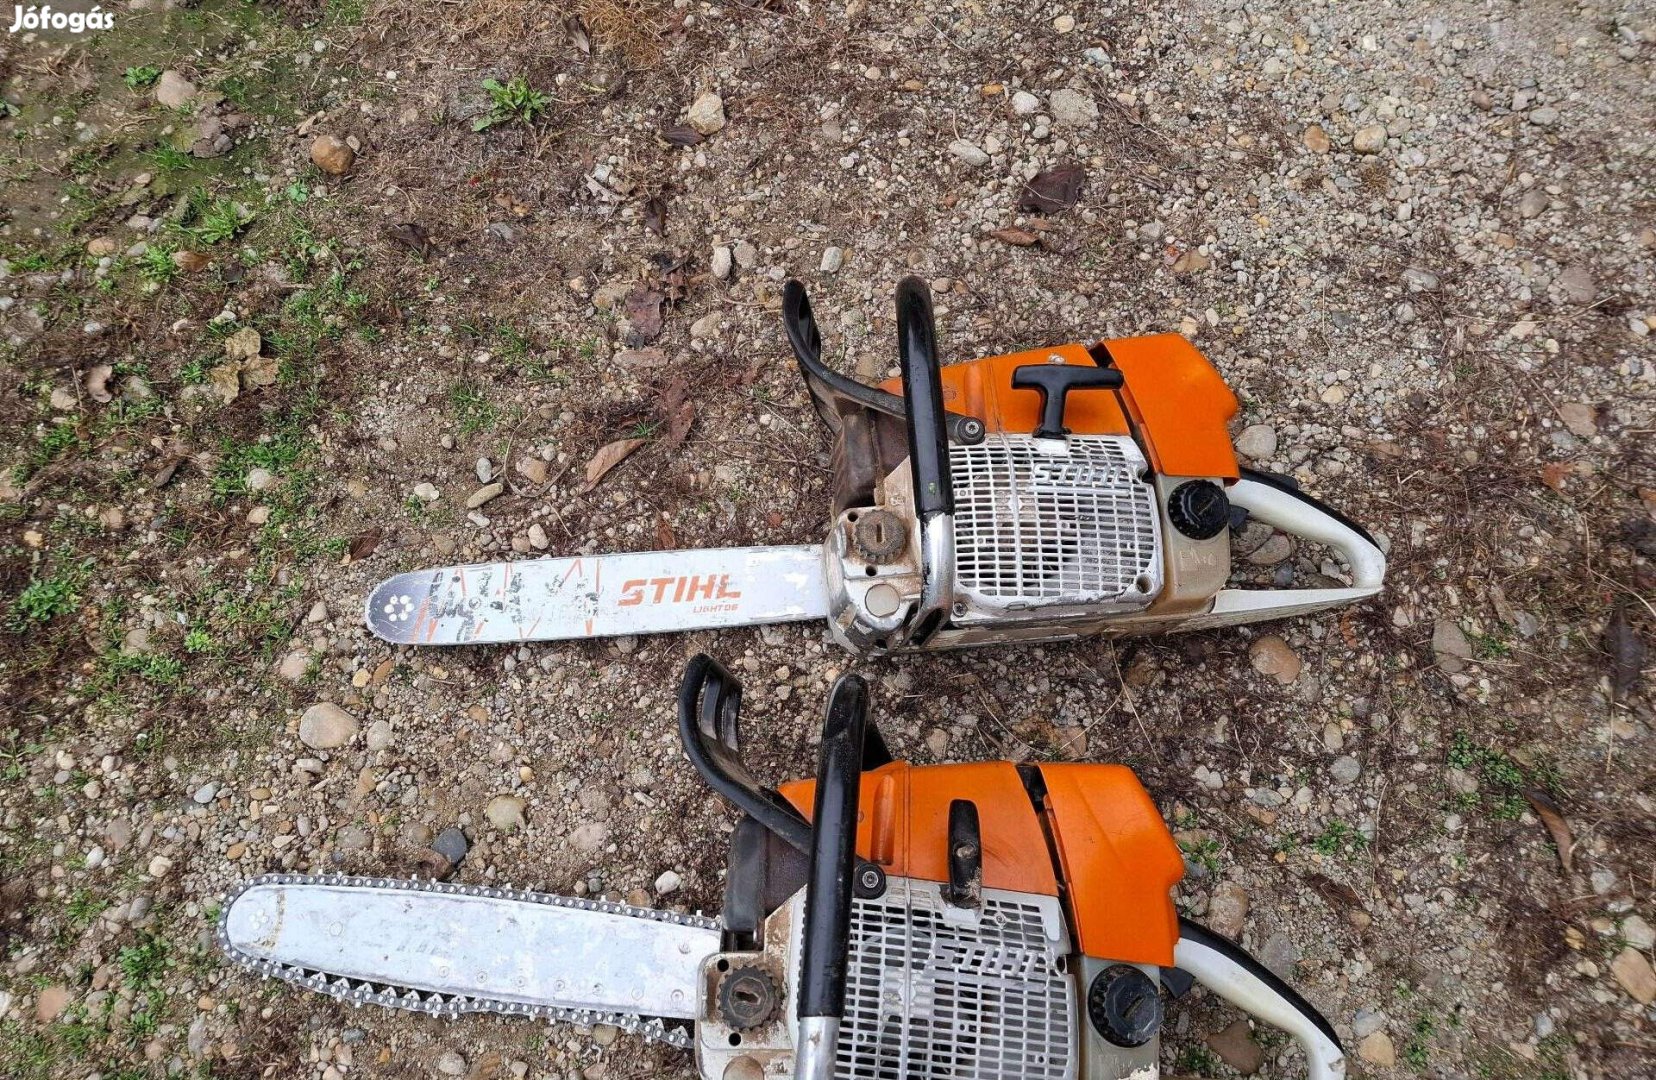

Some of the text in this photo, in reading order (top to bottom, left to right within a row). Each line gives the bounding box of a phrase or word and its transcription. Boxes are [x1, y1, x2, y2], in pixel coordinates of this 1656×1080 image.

[1032, 463, 1130, 486] STIHL
[618, 574, 741, 606] STIHL
[934, 939, 1046, 977] STIHL
